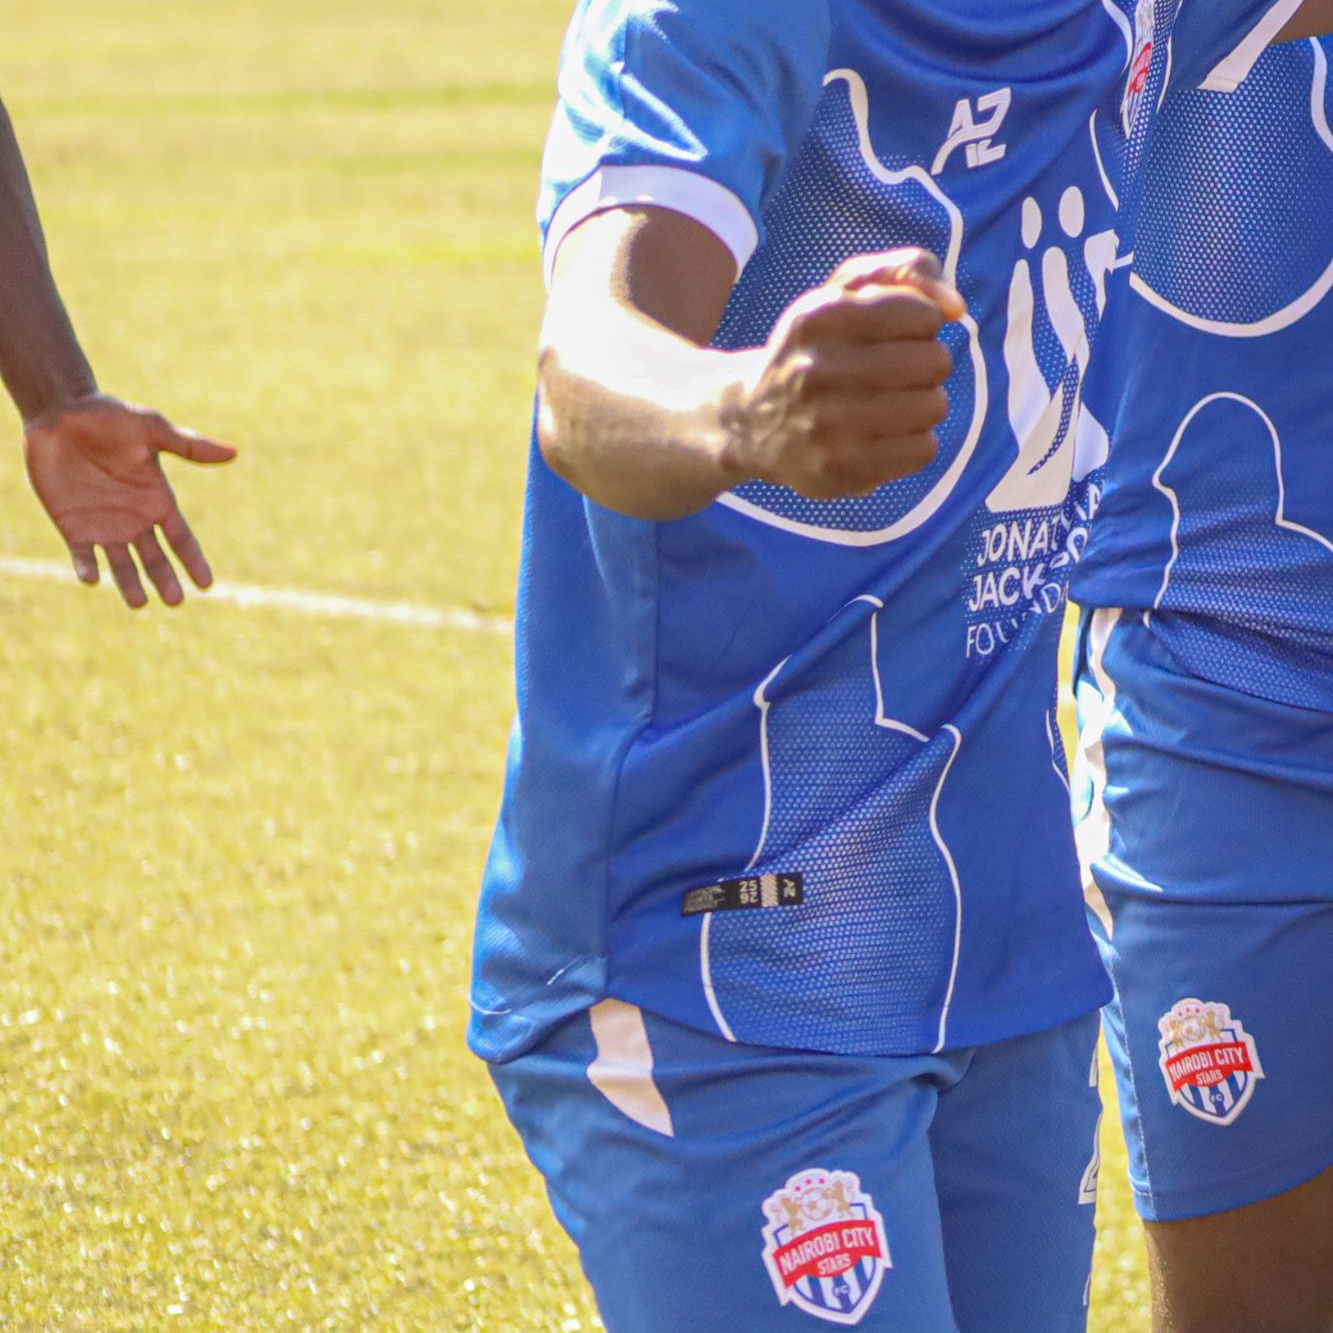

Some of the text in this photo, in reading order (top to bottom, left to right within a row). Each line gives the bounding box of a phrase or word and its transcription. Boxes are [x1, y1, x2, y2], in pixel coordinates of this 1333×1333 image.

[739, 879, 758, 892] 25
[1168, 1047, 1245, 1082] NAIROBI CITY
[1195, 1068, 1223, 1085] STARS
[1210, 1093, 1223, 1103] FC
[779, 1226, 875, 1276] NAIROBI CITY
[816, 1252, 852, 1275] STARS
[834, 1285, 849, 1297] FC
